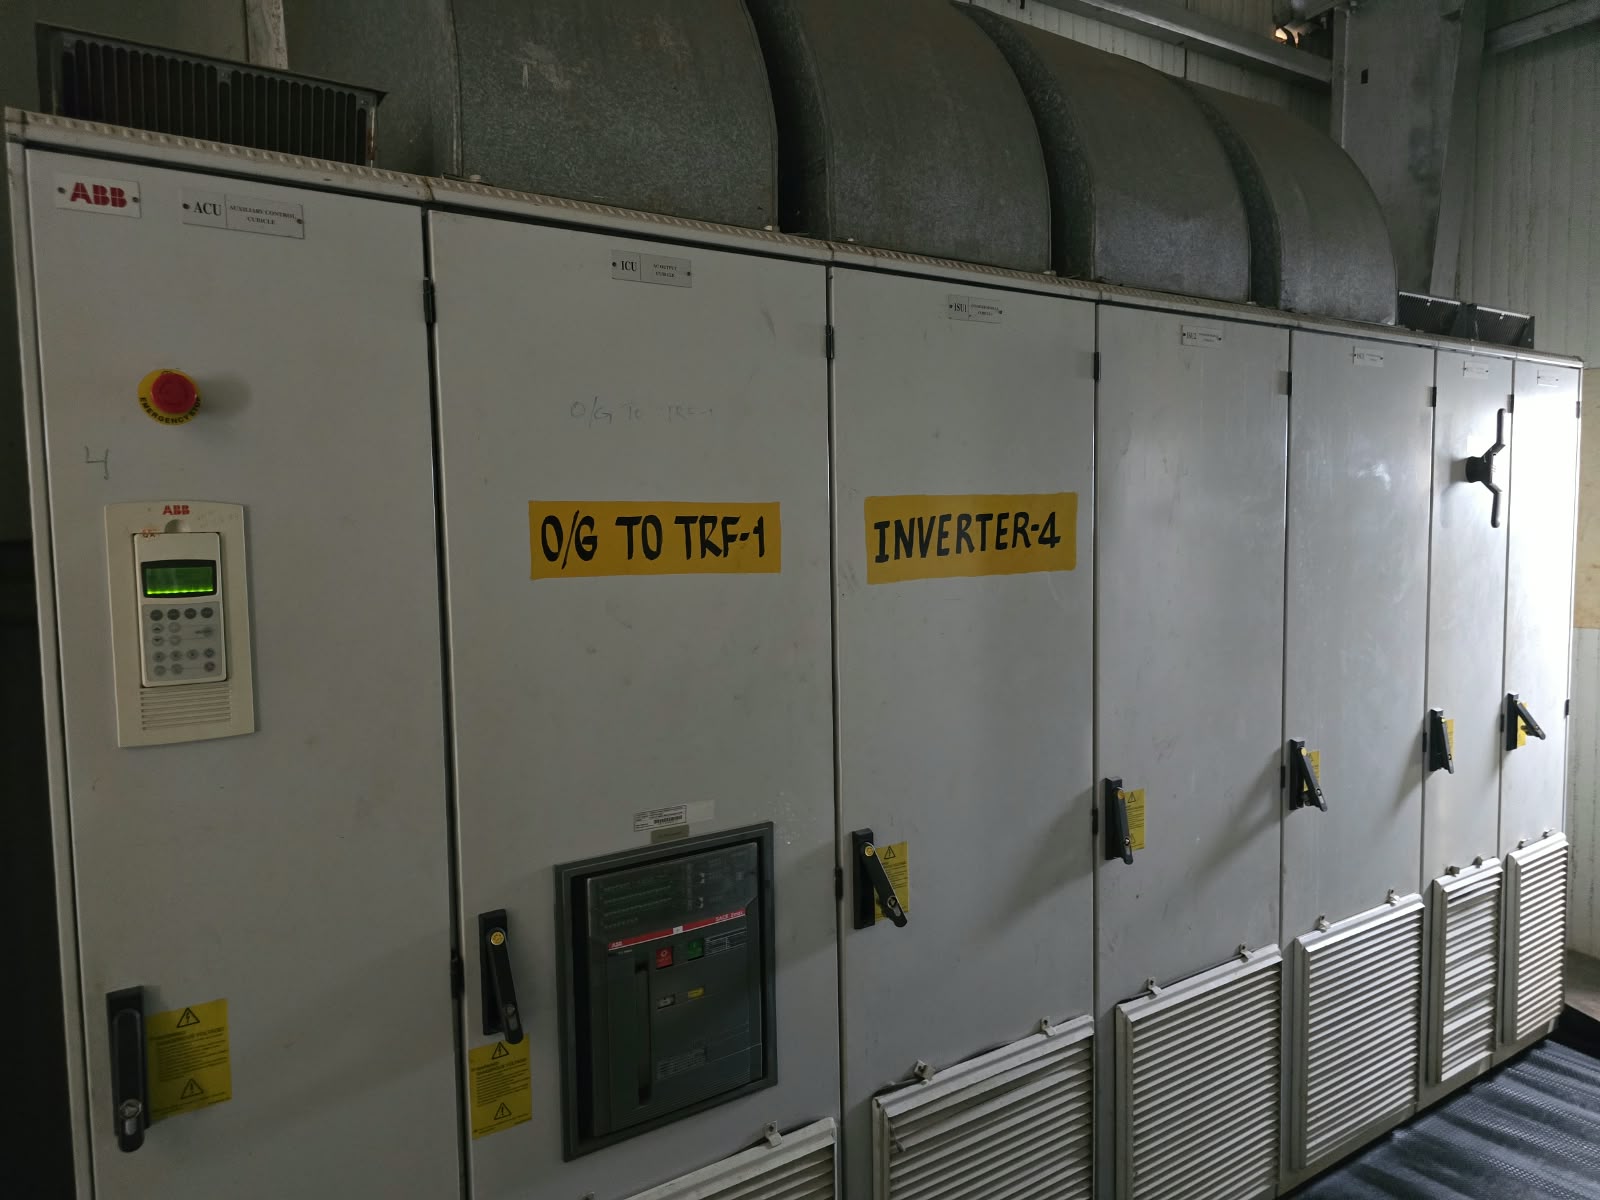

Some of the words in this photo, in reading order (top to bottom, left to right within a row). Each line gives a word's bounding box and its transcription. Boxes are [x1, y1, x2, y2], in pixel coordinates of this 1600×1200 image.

[69, 182, 128, 208] ABB
[193, 201, 222, 216] ACU
[229, 204, 263, 215] AUXILIARY
[264, 208, 296, 219] CONTROL
[247, 216, 276, 226] CUBICLE
[621, 260, 637, 272] ICU
[139, 397, 191, 424] EMERGENCY
[84, 445, 110, 481] 4
[162, 504, 191, 516] ABB
[540, 509, 599, 570] O/G
[614, 514, 664, 561] TO
[673, 514, 766, 561] TRF-1
[873, 511, 1062, 564] INVERTER-4
